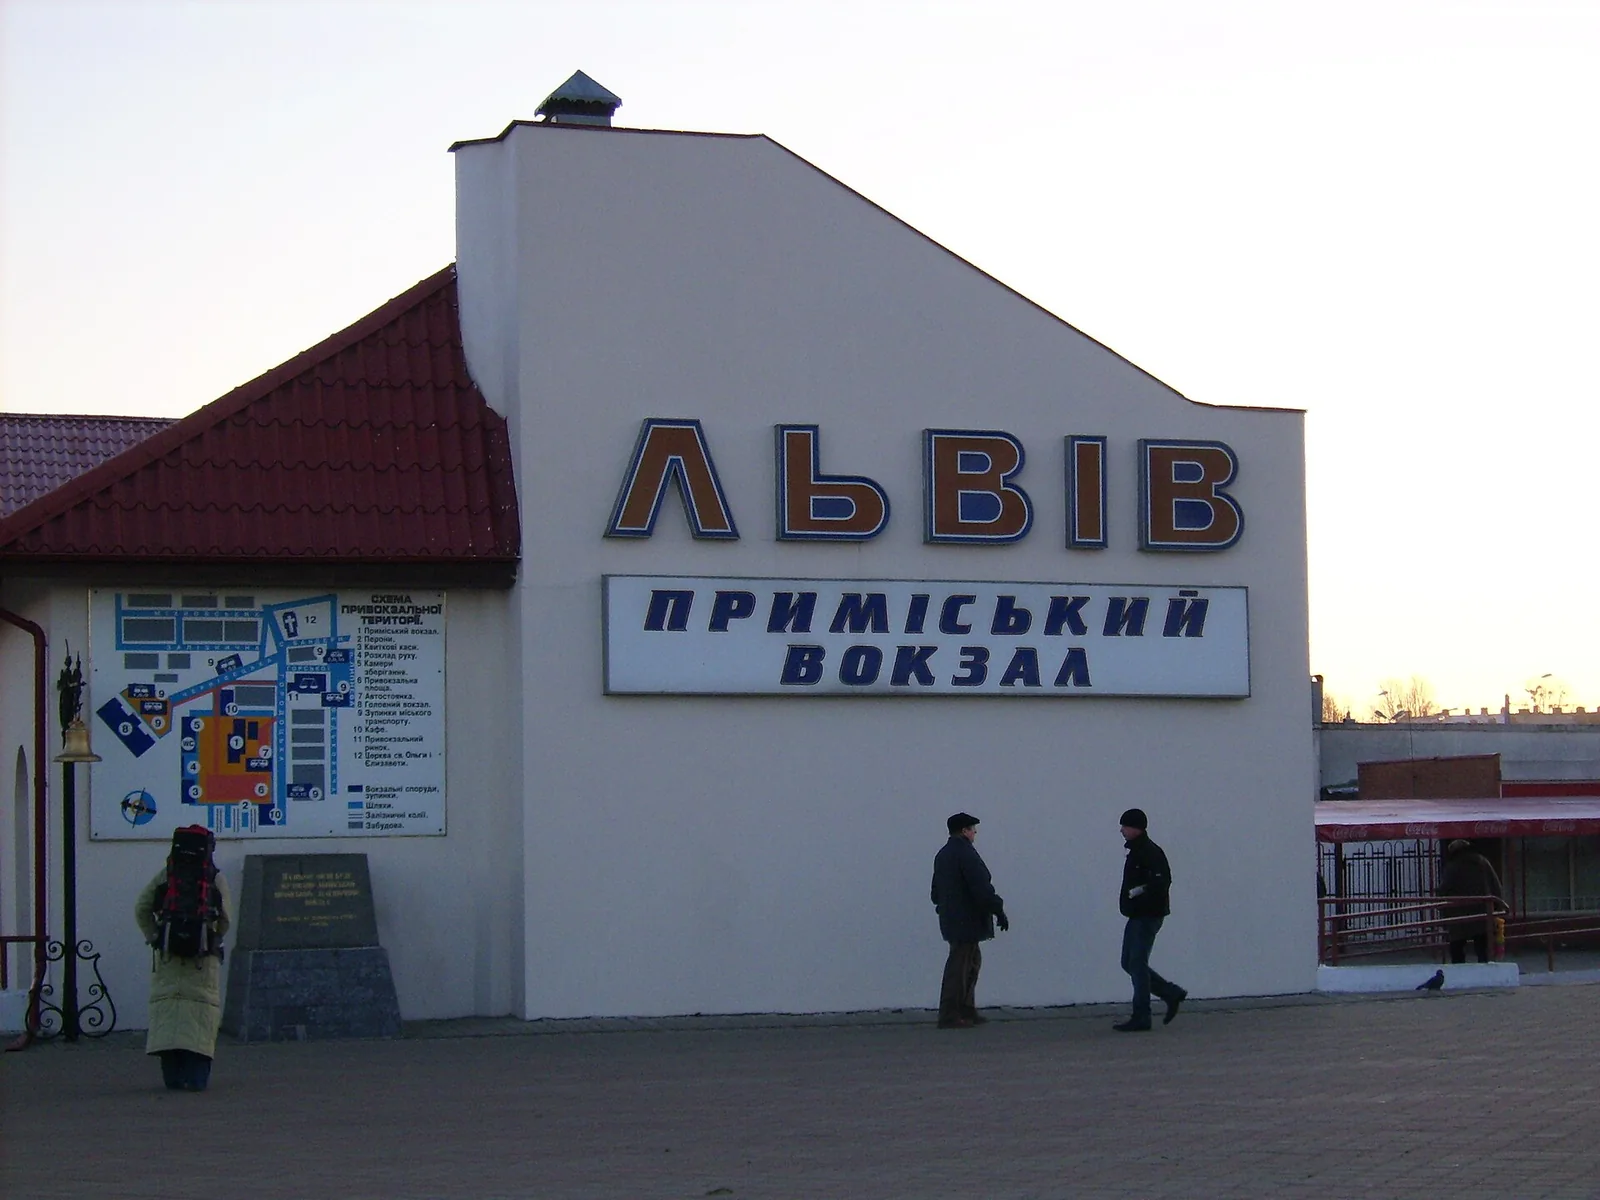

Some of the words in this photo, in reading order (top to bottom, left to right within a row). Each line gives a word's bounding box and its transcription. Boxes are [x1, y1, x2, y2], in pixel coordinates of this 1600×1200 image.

[603, 417, 1245, 552] ЛЬВІВ
[371, 594, 412, 603] СХЕМА
[341, 604, 442, 614] ПРИВОКЗАЛЬНОЇ
[643, 589, 1211, 638] ПРИМІСЬКИЙ
[305, 616, 316, 624] 12
[364, 627, 408, 636] Приміський
[364, 643, 397, 651] Квиткові
[318, 648, 323, 656] 9
[208, 658, 214, 667] 9
[364, 660, 393, 668] Камери
[780, 644, 1092, 688] ВОКЗАЛ
[364, 668, 408, 676] зберігання.
[364, 677, 418, 685] Привокзальна
[158, 690, 164, 698] 9
[288, 693, 299, 701] 11
[226, 705, 238, 713] 10
[365, 709, 397, 718] Зупинки
[155, 719, 161, 727] 9
[194, 721, 200, 729] 5
[365, 718, 411, 726] транспорту.
[122, 725, 129, 733] 8
[183, 739, 195, 747] WC
[365, 735, 424, 744] Привокзальний
[262, 749, 269, 757] 7
[365, 752, 391, 760] Церква
[405, 751, 428, 759] Ольги
[189, 763, 196, 771] 4
[193, 788, 198, 796] 3
[258, 785, 264, 793] 6
[242, 802, 248, 810] 2
[270, 811, 281, 819] 10
